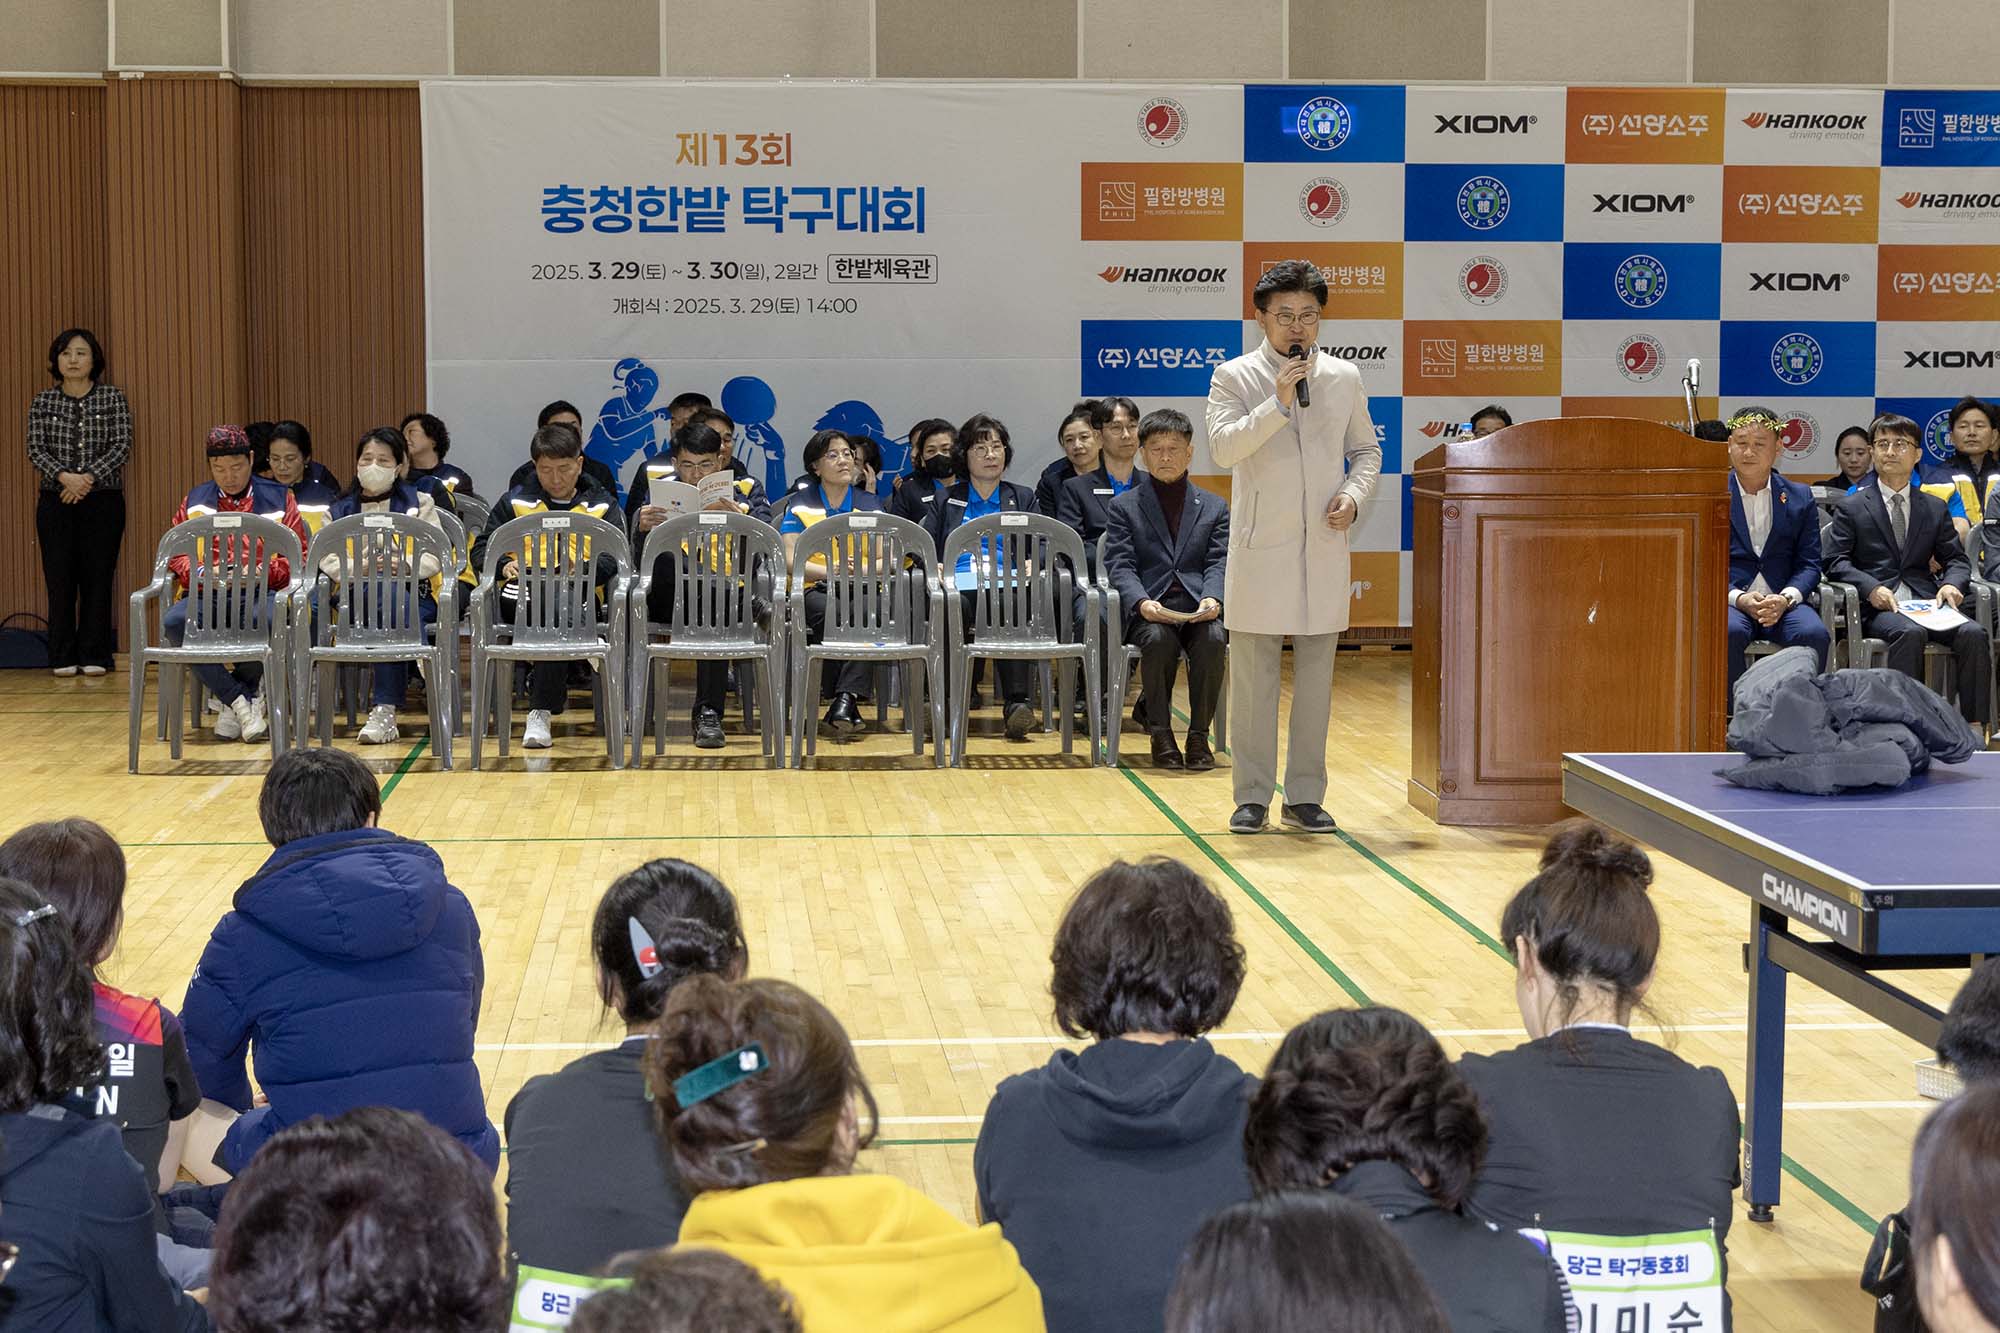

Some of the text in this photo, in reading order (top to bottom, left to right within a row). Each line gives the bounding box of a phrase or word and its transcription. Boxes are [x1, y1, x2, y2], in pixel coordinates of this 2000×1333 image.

[1618, 114, 1709, 137] 선양소주
[1789, 130, 1865, 140] driving emotion
[676, 132, 793, 167] 제13회
[1144, 187, 1225, 207] 필한방병원
[1774, 193, 1863, 216] 선양소주
[541, 184, 925, 234] 충청한밭 탁구대회
[531, 264, 584, 280] 2025.
[611, 262, 667, 281] 29(토)
[775, 264, 818, 280] 2일간
[835, 258, 931, 279] 한밭체육관
[1317, 266, 1385, 286] 한방병원
[1148, 284, 1225, 295] driving emotion
[1928, 272, 2000, 294] 선양소
[613, 298, 660, 314] 개회식
[673, 299, 725, 314] 2025.
[751, 298, 800, 315] 29(토)
[808, 298, 857, 314] 14:00
[1465, 344, 1544, 363] 필한방병원
[1762, 872, 1847, 936] CHAMPION
[1567, 1254, 1689, 1277] 당근 탁구동호회
[542, 1292, 570, 1315] 당근
